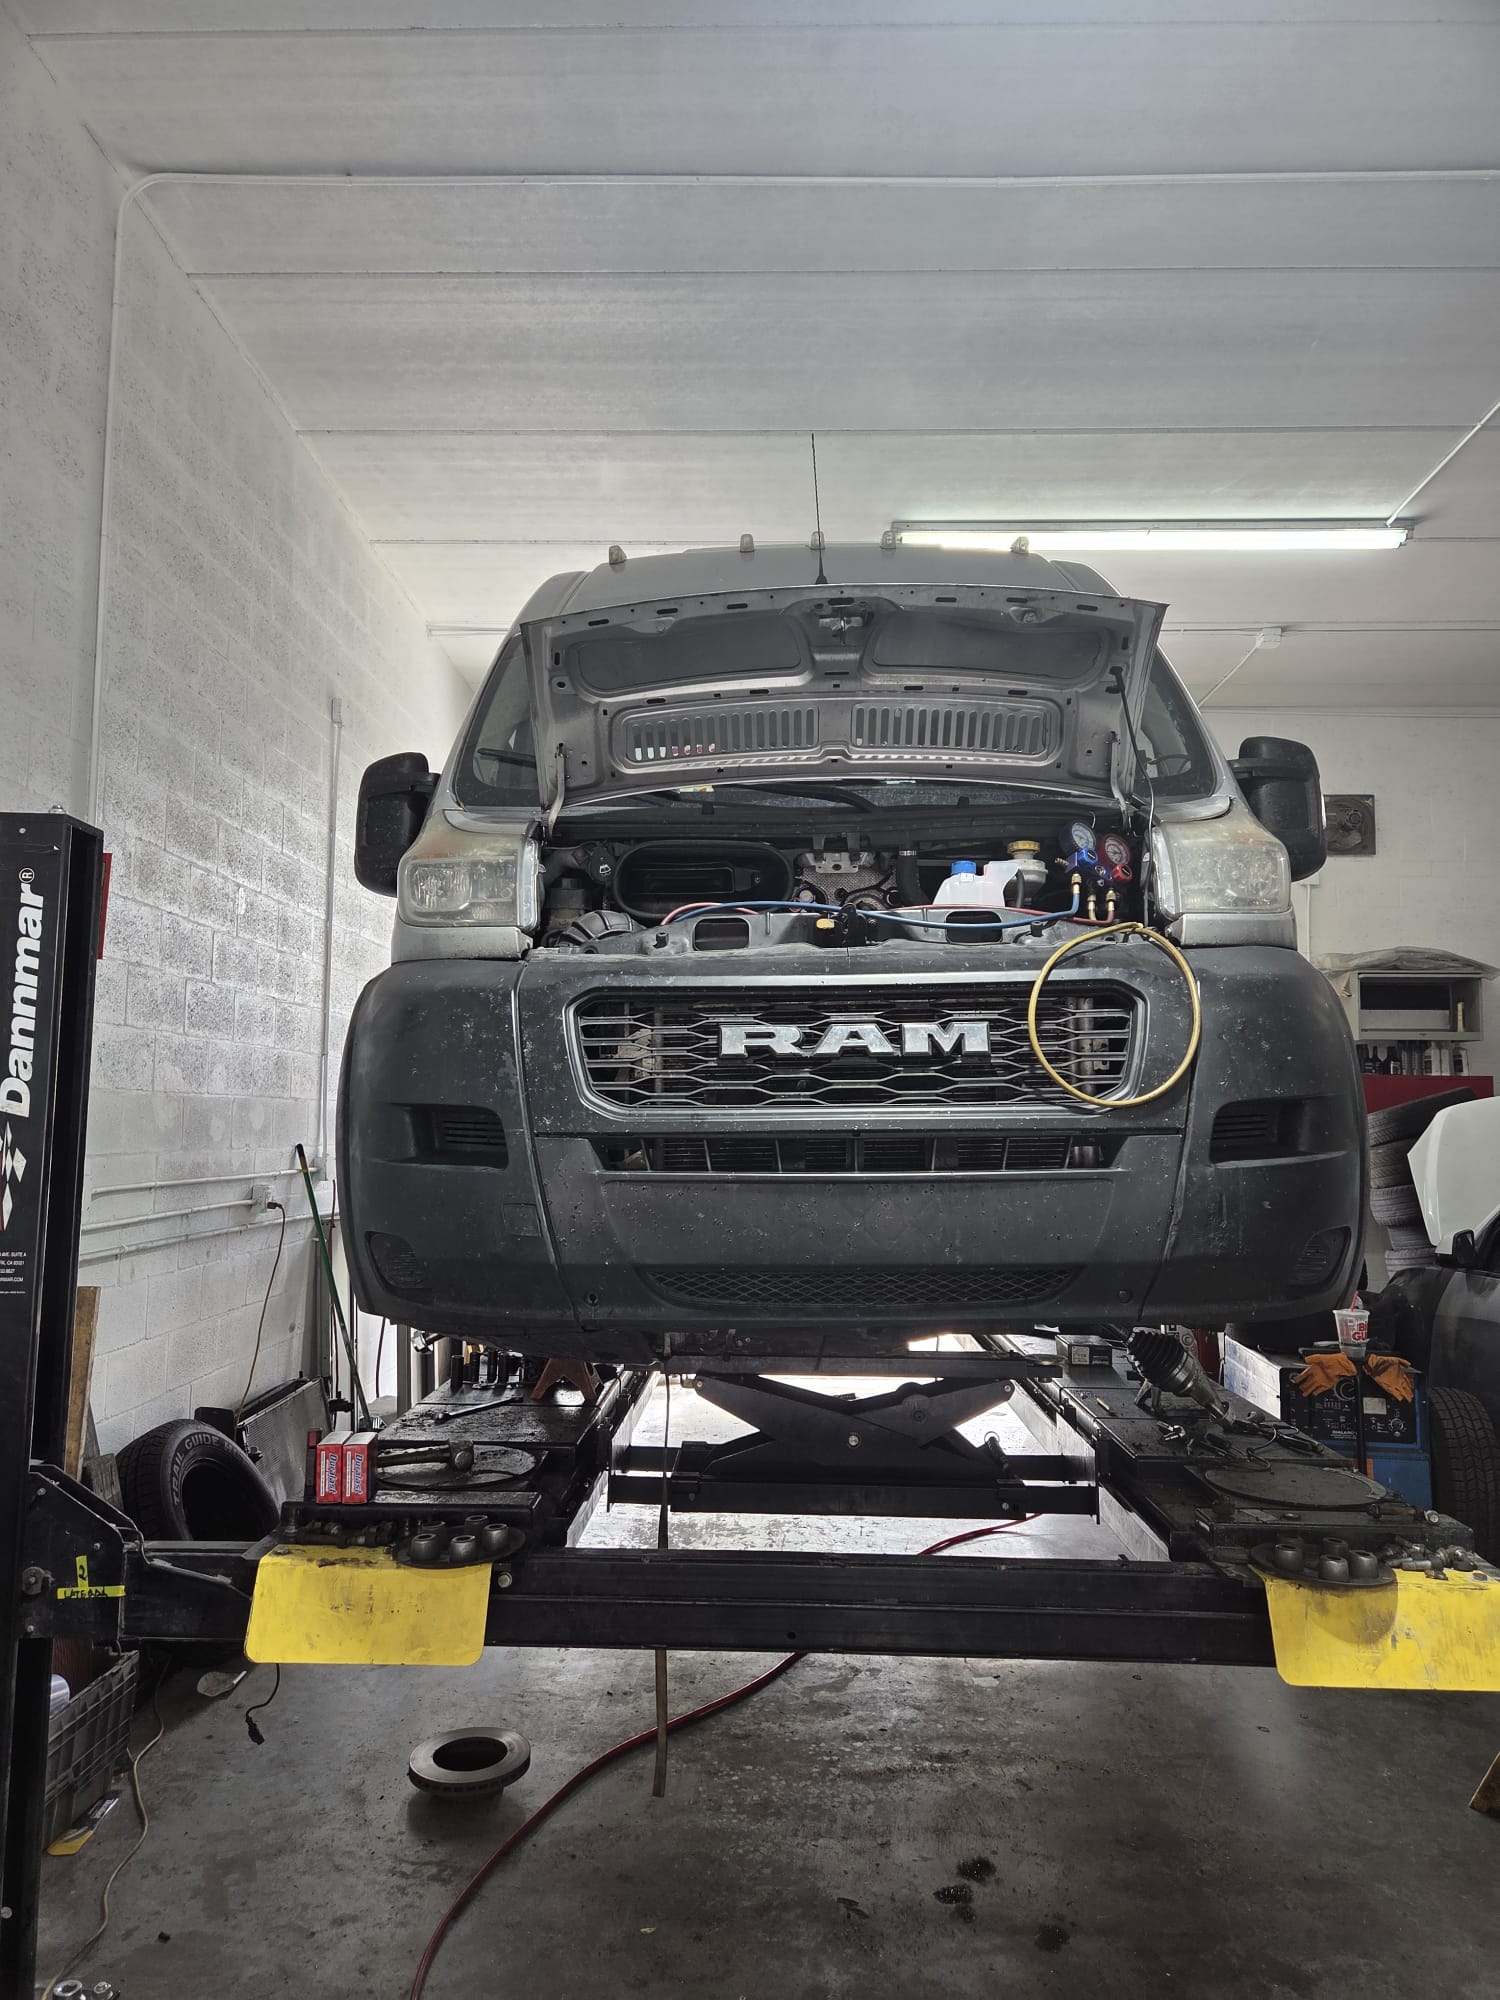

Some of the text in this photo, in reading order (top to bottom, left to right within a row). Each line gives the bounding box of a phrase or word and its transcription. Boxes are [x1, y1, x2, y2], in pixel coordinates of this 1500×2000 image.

[719, 1021, 990, 1058] RAM
[172, 1433, 220, 1506] TRAIL GUIDE
[328, 1453, 338, 1494] Duralast
[354, 1453, 363, 1494] Duralast
